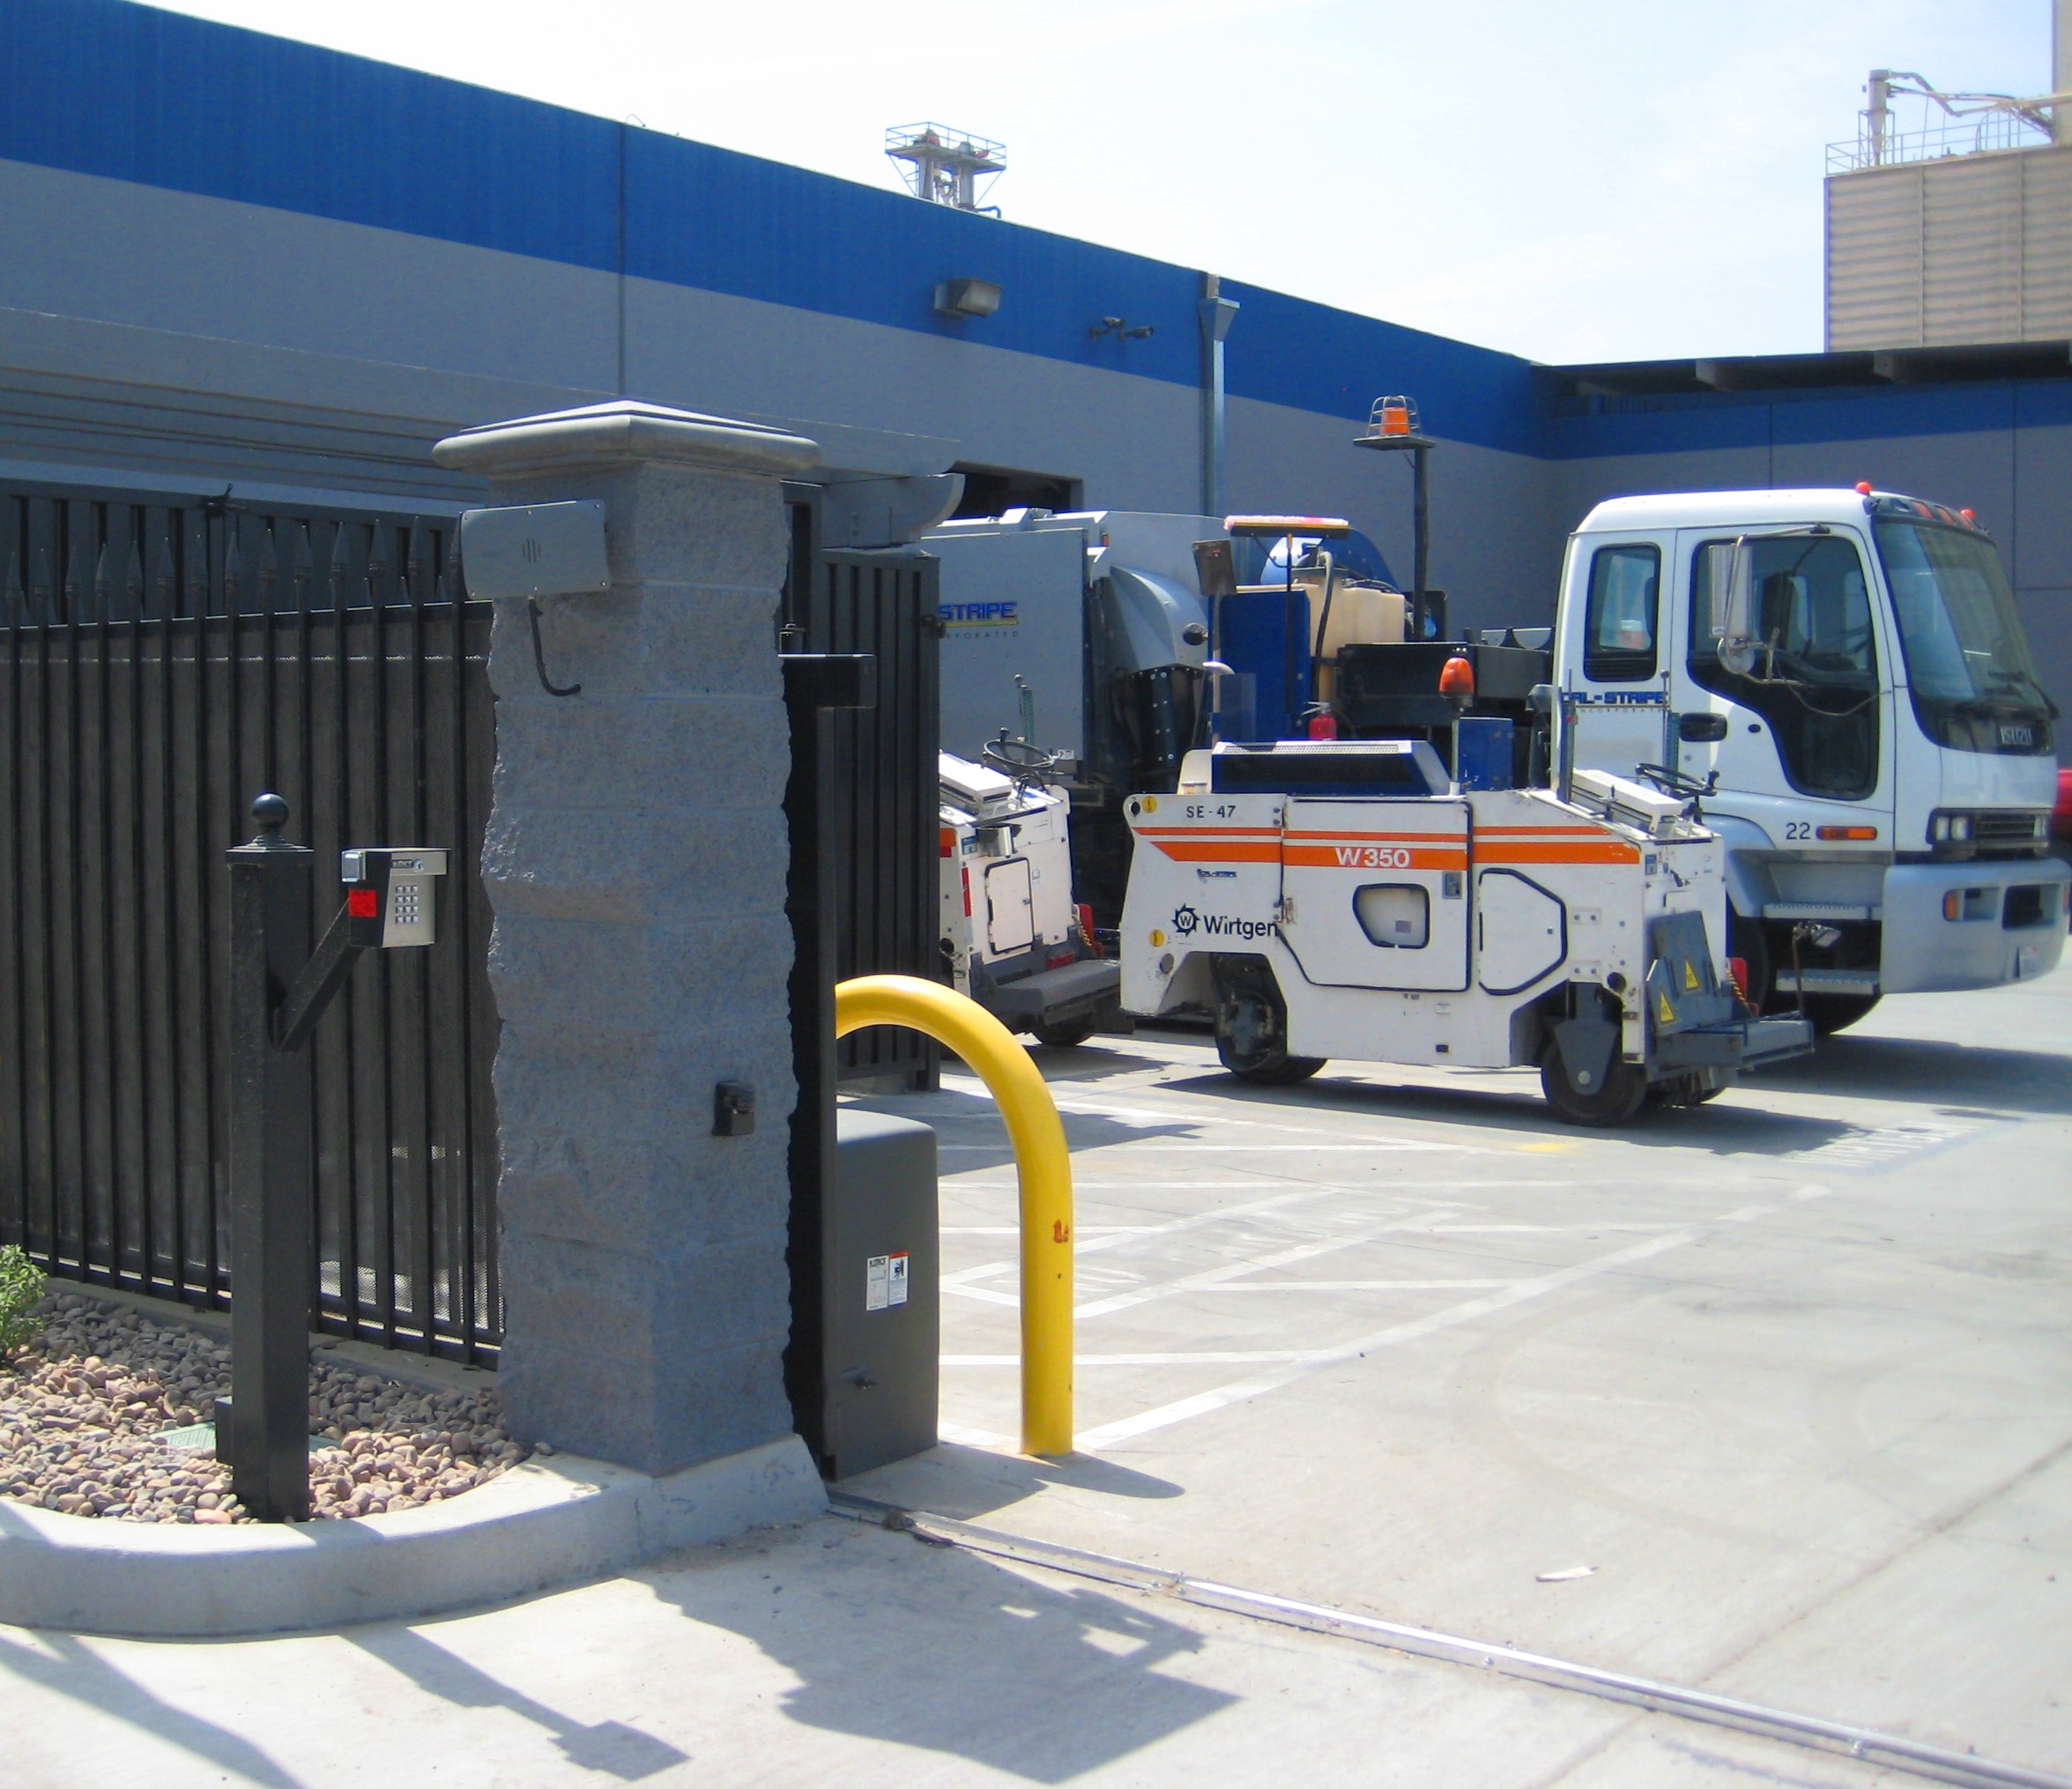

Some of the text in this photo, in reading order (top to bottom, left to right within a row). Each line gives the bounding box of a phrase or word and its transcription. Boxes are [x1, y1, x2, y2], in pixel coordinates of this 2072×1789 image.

[938, 602, 1017, 620] STRIPE
[1786, 821, 1811, 840] 22
[1203, 915, 1281, 940] Wirtgen
